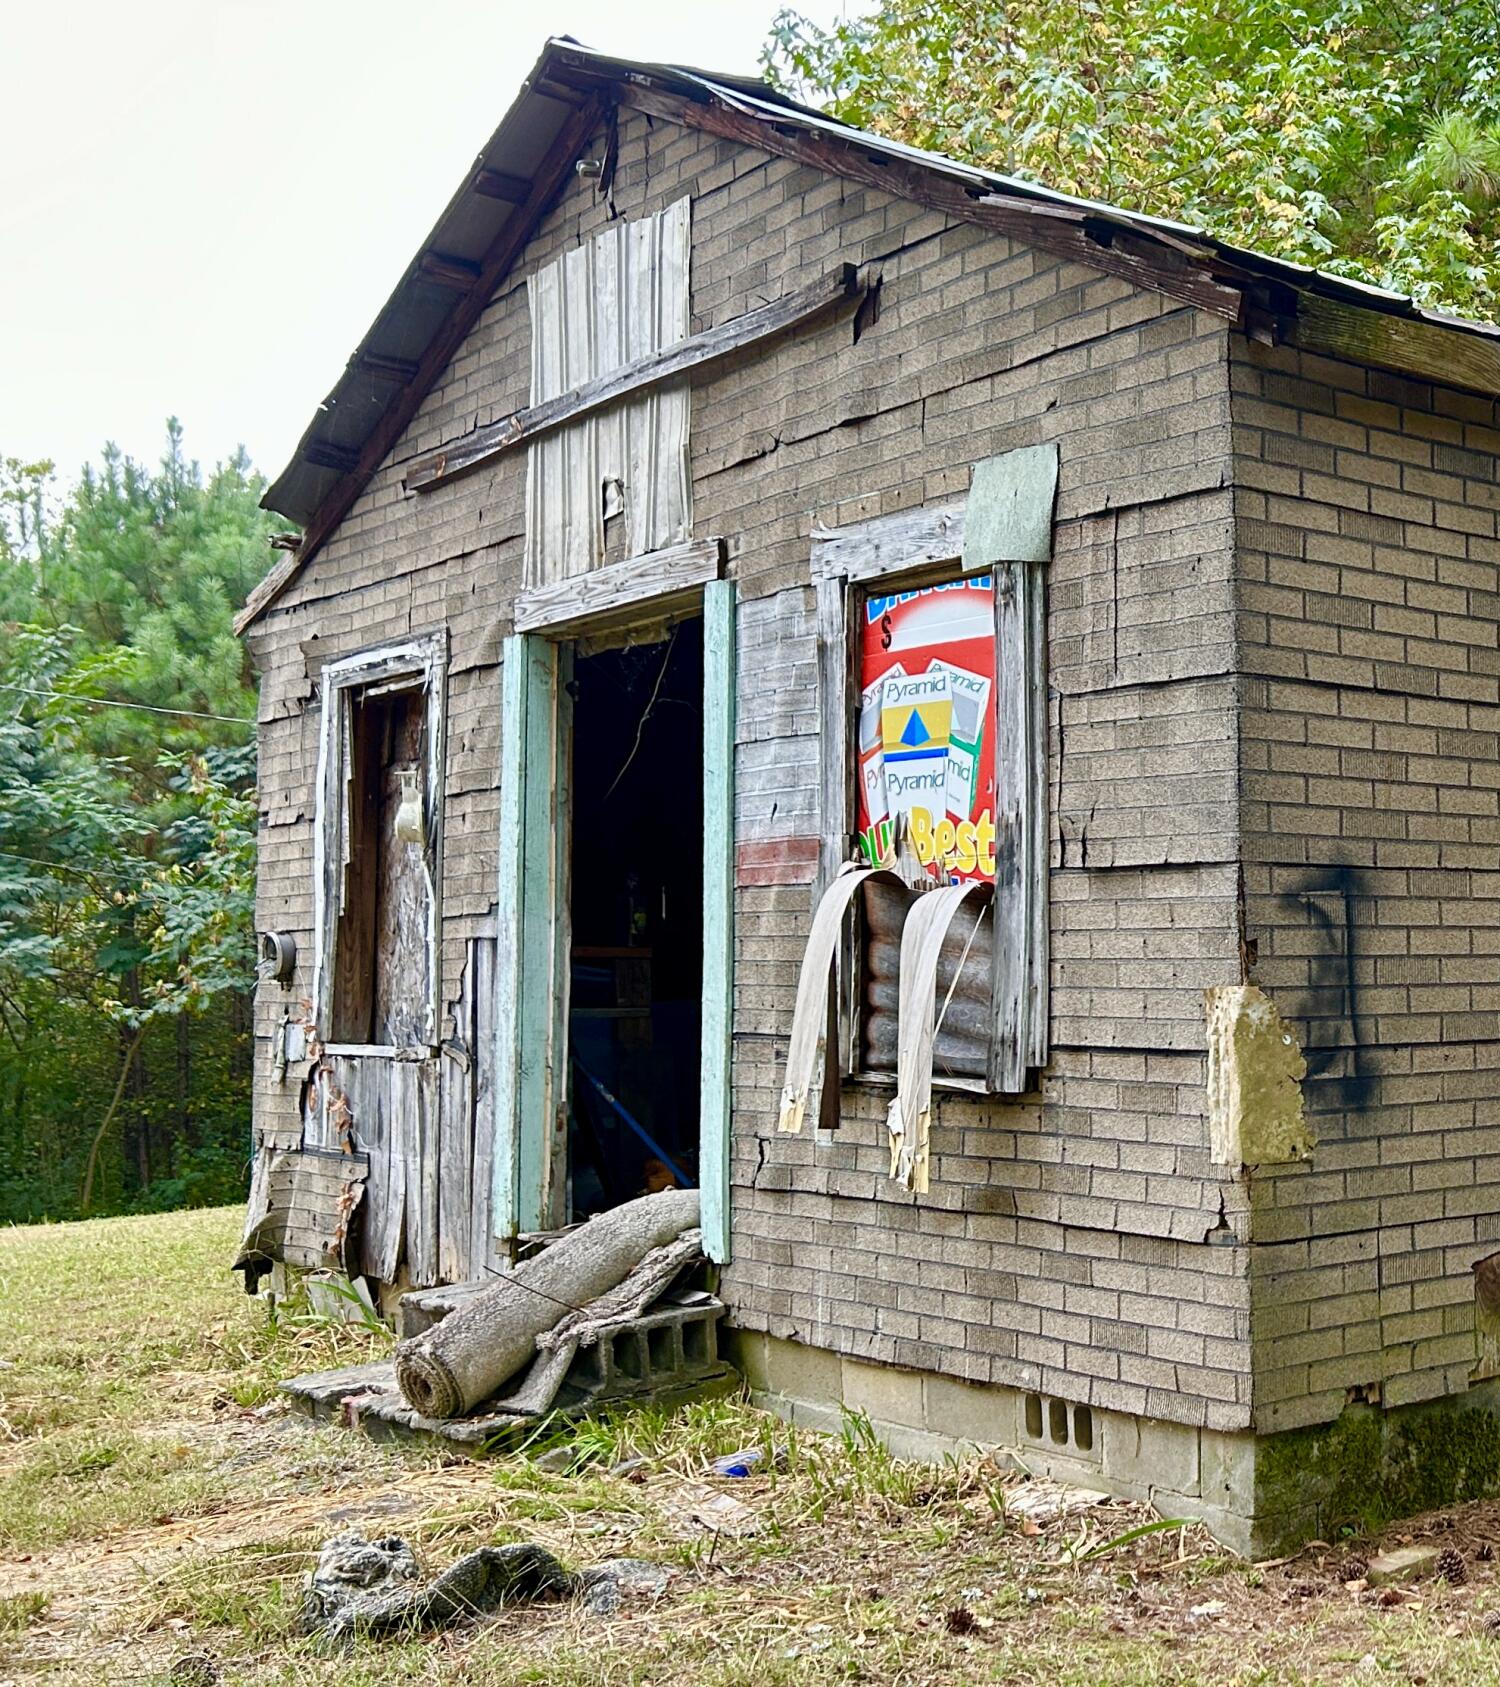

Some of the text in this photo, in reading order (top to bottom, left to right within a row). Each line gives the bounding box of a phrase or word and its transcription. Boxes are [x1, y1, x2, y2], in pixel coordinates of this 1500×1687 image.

[881, 612, 892, 652] $
[886, 675, 946, 703] Pyramid
[888, 769, 945, 796] Pyramid
[908, 806, 996, 877] Best
